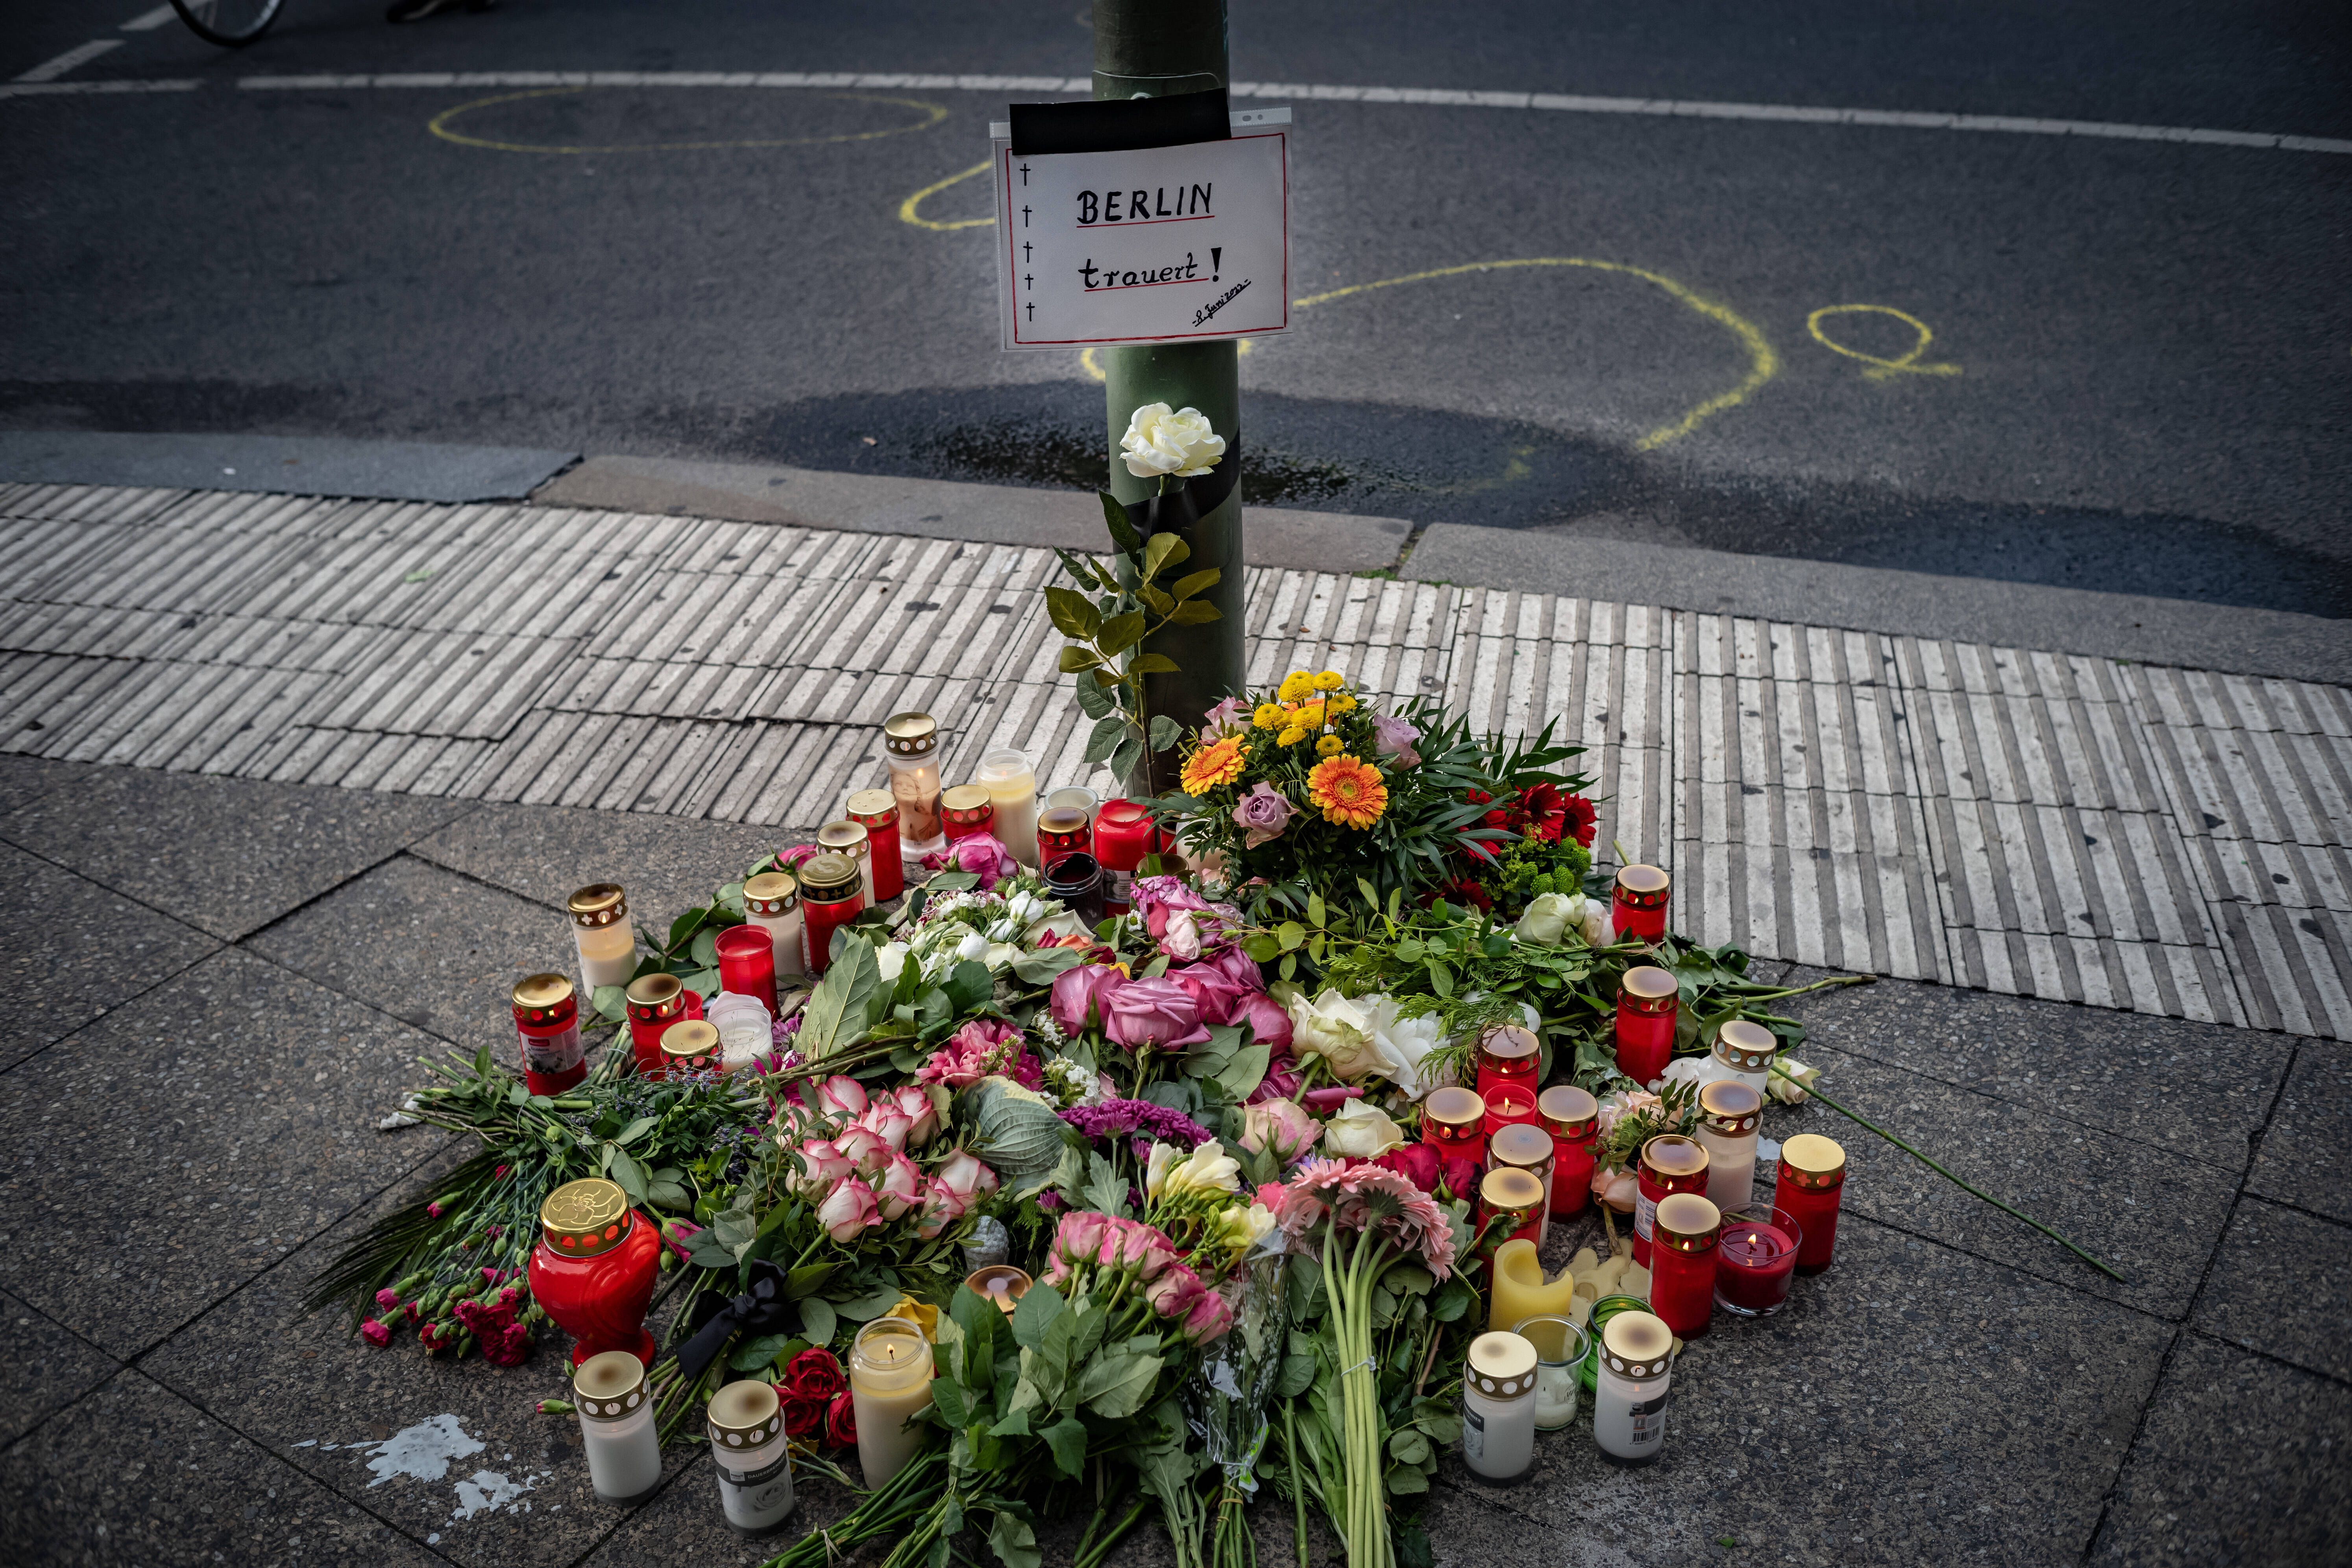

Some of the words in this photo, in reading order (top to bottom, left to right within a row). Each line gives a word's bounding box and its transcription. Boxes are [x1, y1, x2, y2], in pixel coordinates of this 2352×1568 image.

[1076, 182, 1212, 224] BERLIN
[1078, 252, 1198, 288] trauert
[1204, 295, 1225, 319] Juni
[747, 1455, 785, 1479] DAUERBRENNER
